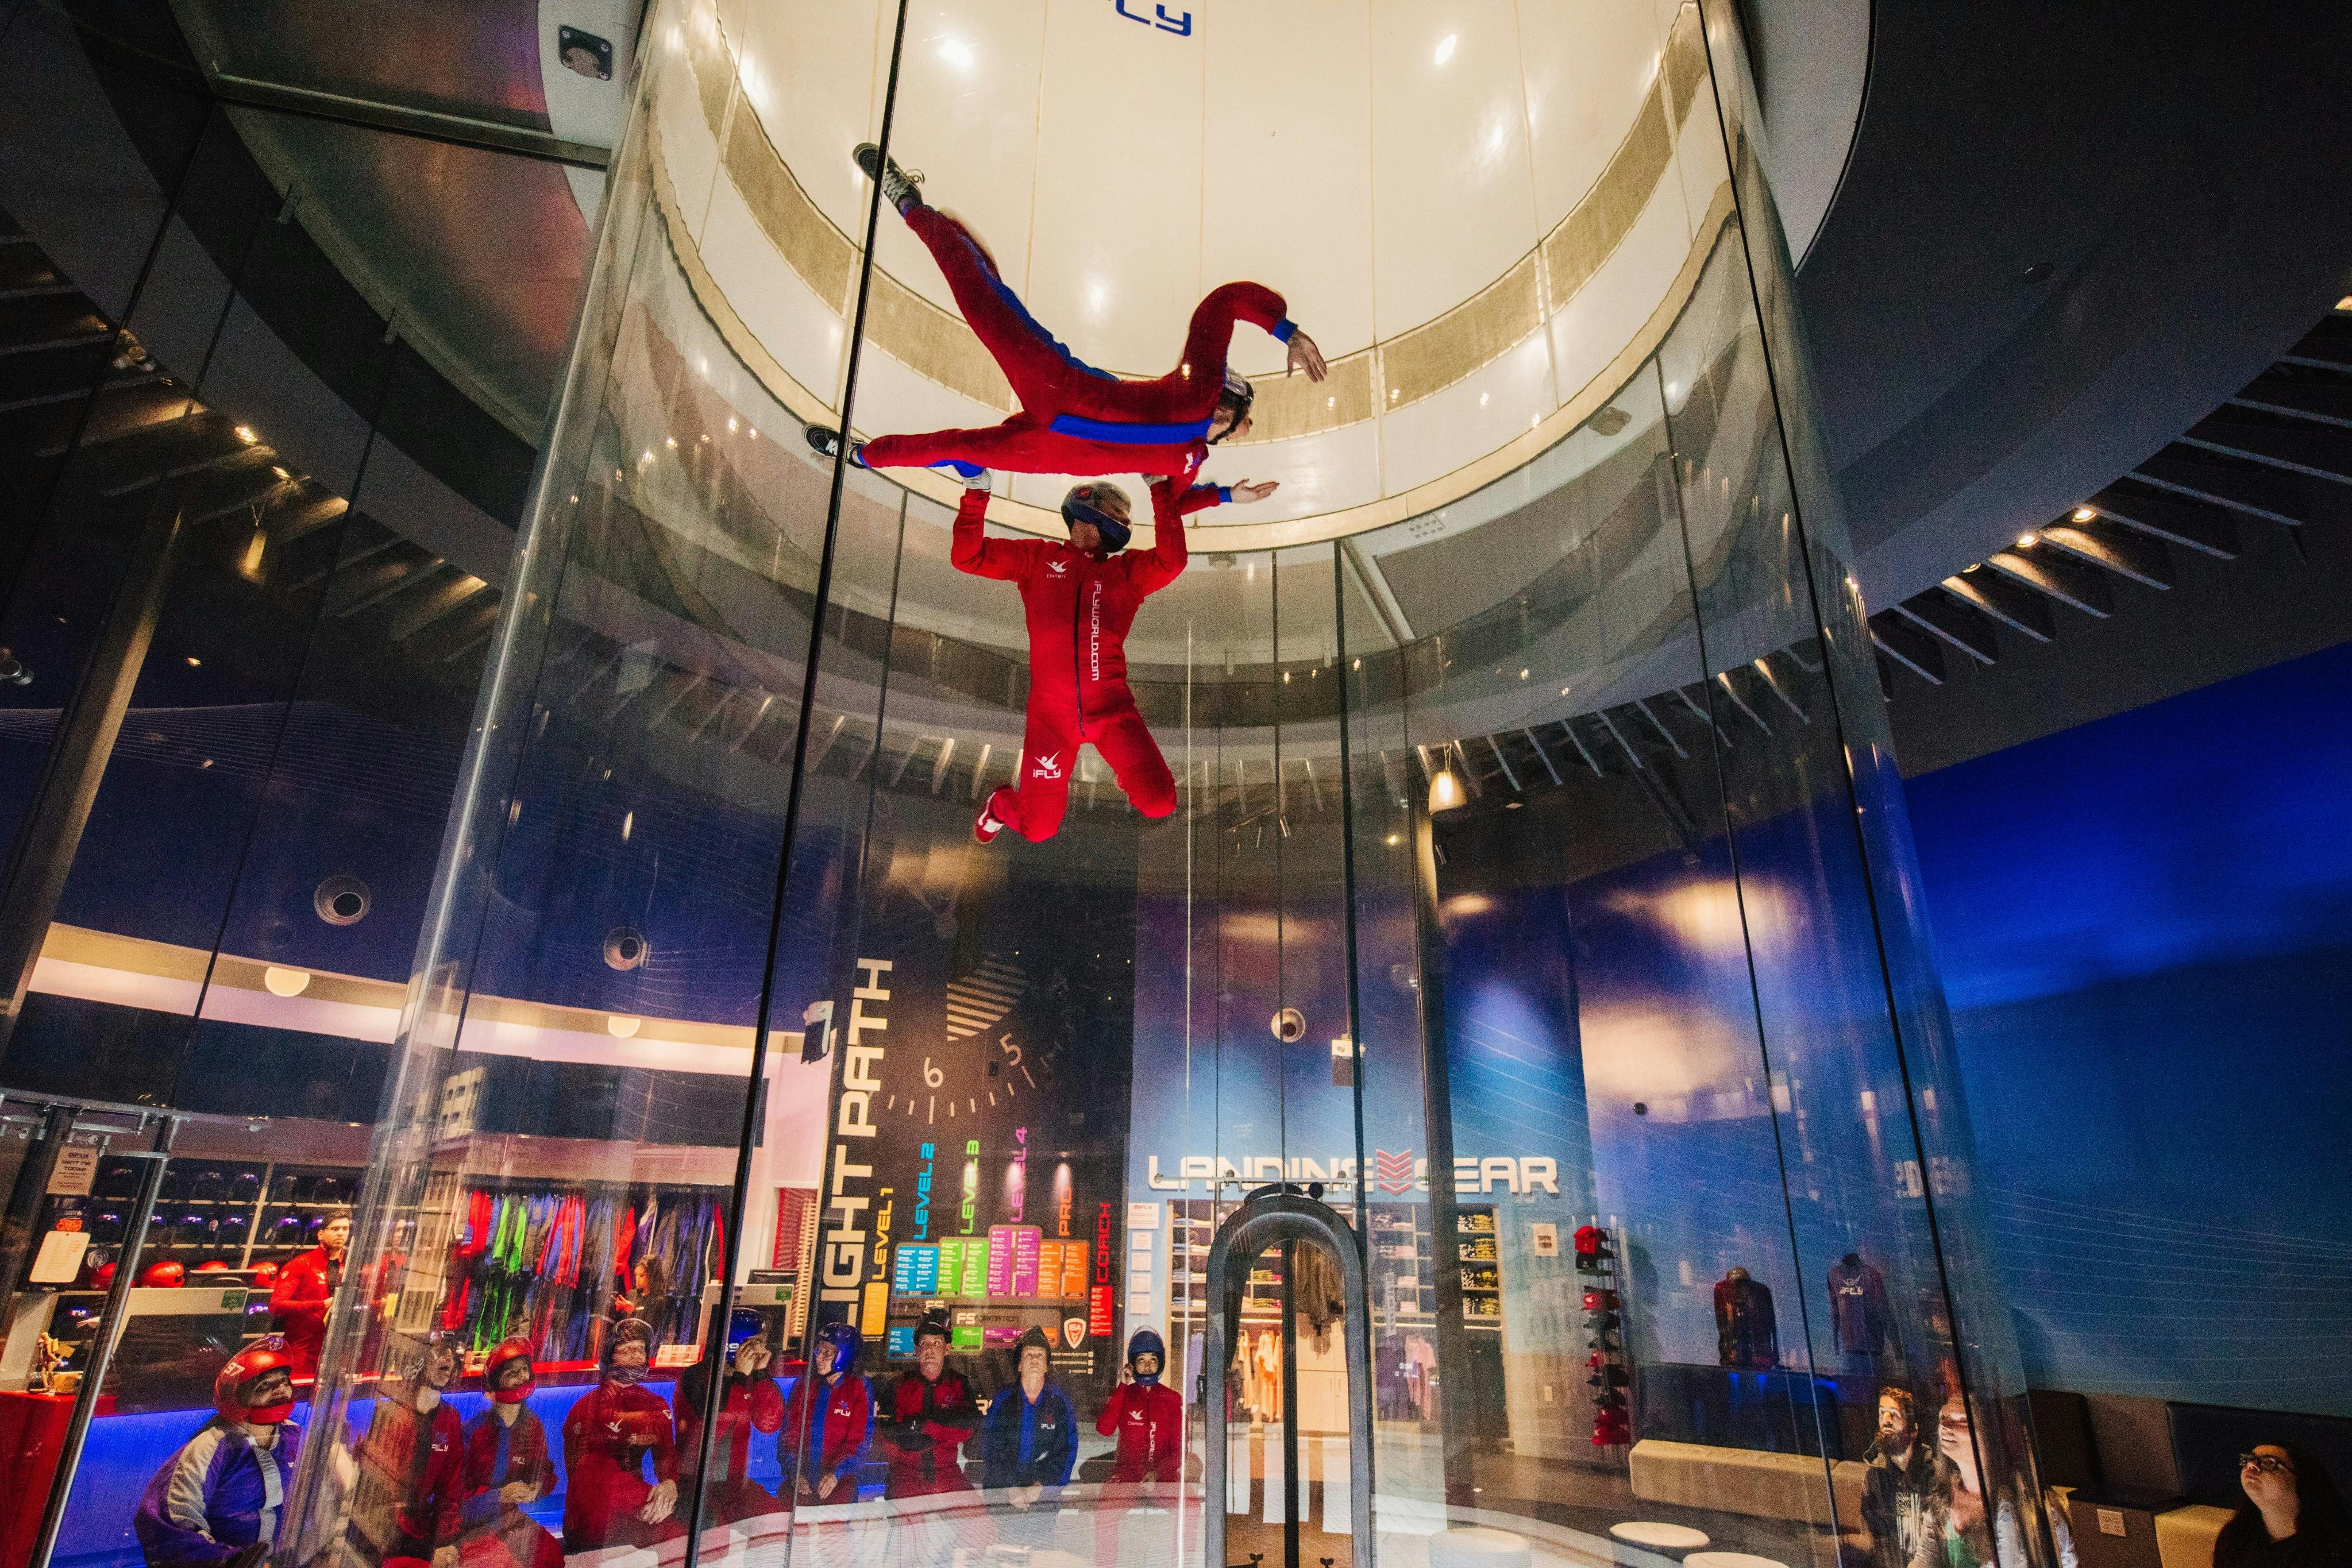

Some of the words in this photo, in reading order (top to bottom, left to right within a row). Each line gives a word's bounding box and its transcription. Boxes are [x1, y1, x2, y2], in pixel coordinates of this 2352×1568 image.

[1032, 768, 1061, 779] iFLY
[838, 957, 893, 1137] PATH
[999, 1033, 1023, 1067] 5
[923, 1056, 944, 1088] 6
[920, 1143, 935, 1161] 2
[965, 1140, 980, 1156] 3
[1015, 1127, 1028, 1144] 4
[1148, 1155, 1374, 1192] LANDING
[880, 1187, 894, 1197] 1
[912, 1163, 934, 1240] LEVEL
[959, 1158, 978, 1234] LEVEL
[1058, 1185, 1073, 1237] PRO
[820, 1145, 873, 1328] IGHT
[872, 1200, 893, 1280] LEVEL
[1096, 1203, 1112, 1283] COACH
[956, 1312, 976, 1324] FS
